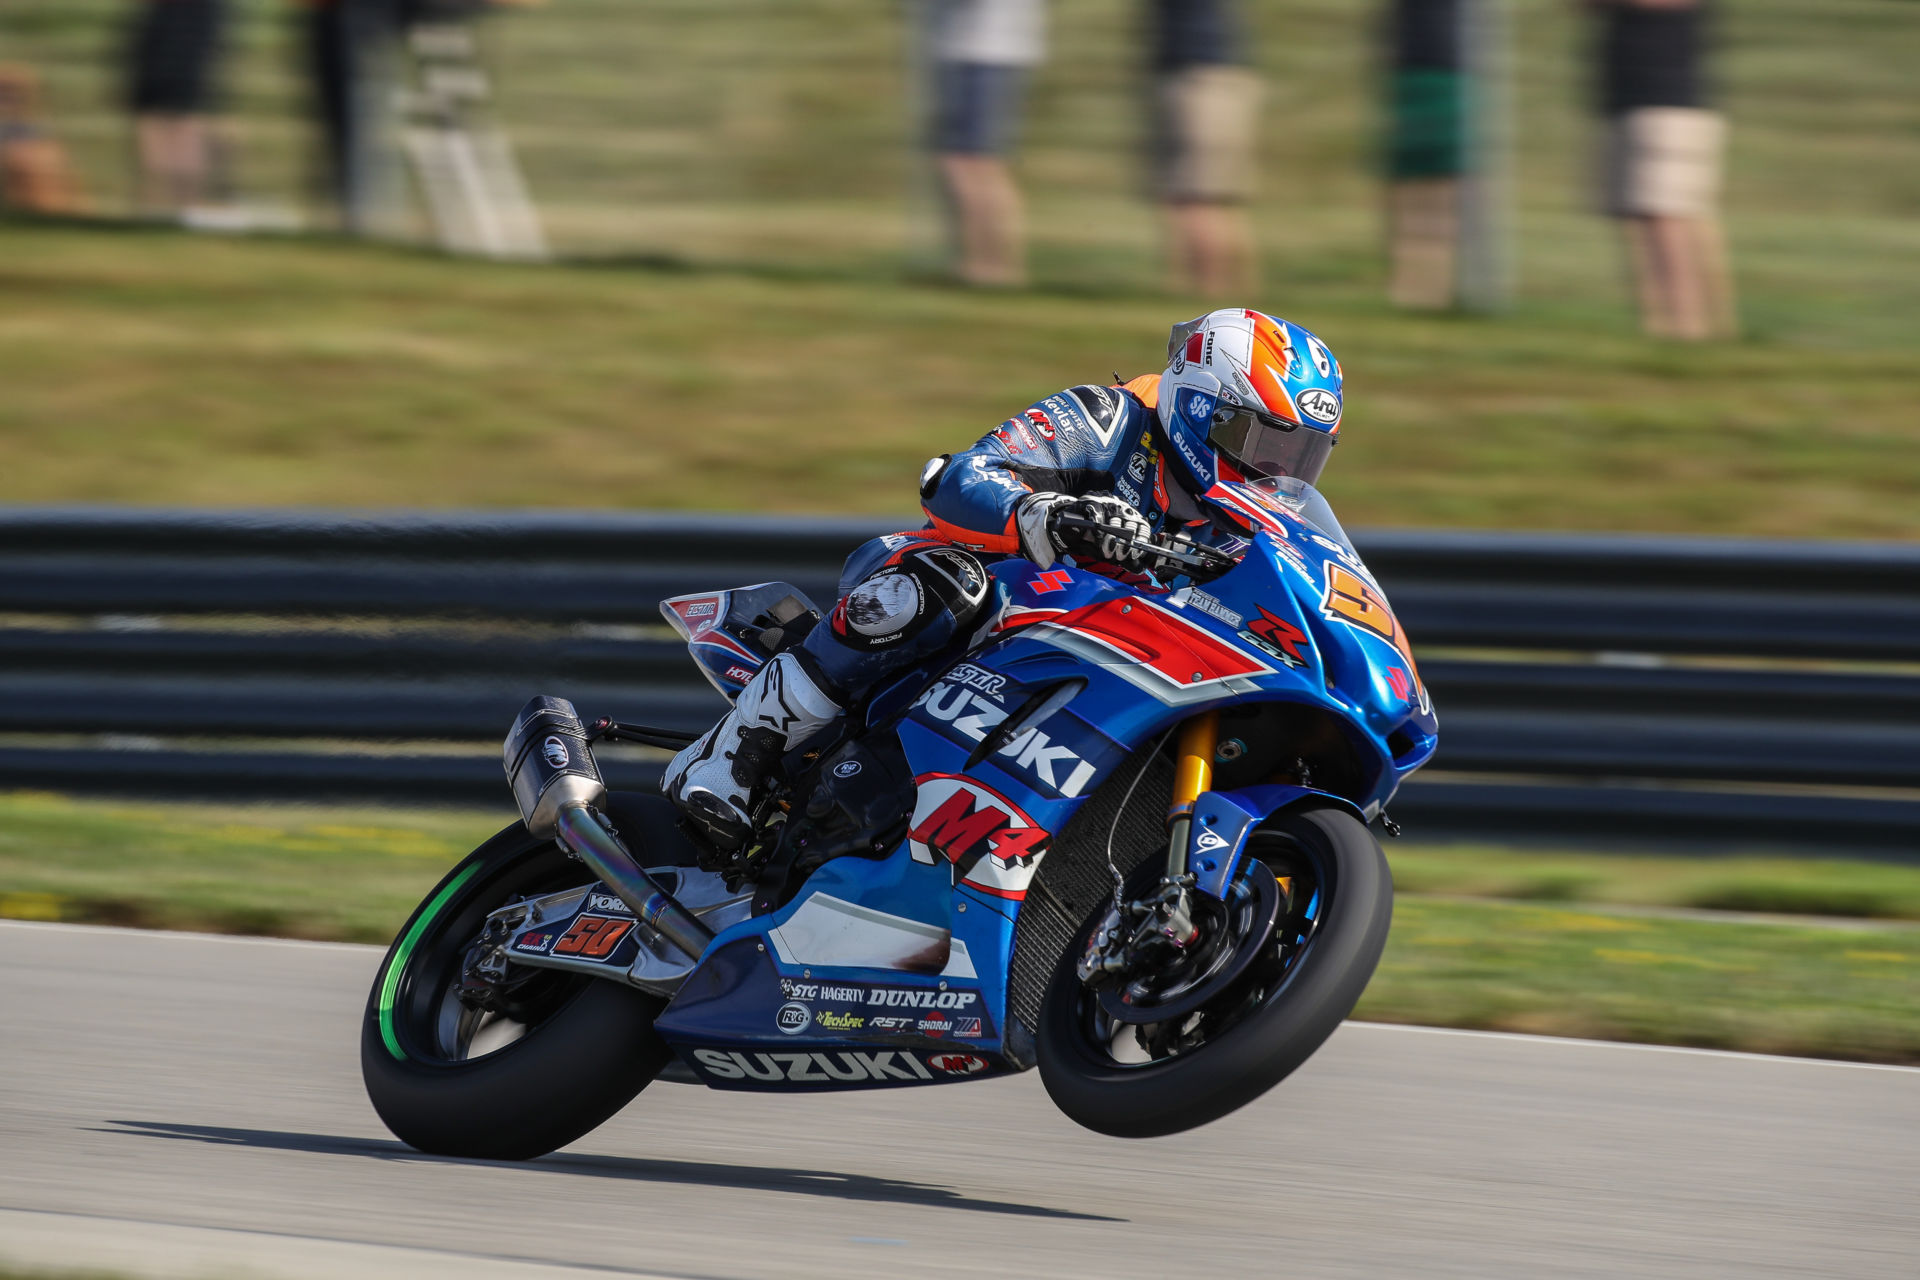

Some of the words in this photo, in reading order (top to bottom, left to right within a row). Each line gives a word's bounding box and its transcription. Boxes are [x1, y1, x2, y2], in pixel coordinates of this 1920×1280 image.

[1041, 398, 1075, 433] Kevlar
[1301, 392, 1337, 416] Arai
[1173, 431, 1212, 482] SUZUKI
[1208, 602, 1243, 628] HAMMER
[1237, 629, 1305, 669] GSX
[909, 788, 1051, 866] M4
[521, 932, 545, 946] EK
[555, 916, 633, 956] 50
[792, 984, 818, 998] STG
[820, 986, 865, 1002] HAGERTY
[866, 988, 977, 1009] DUNLOP
[782, 1010, 805, 1024] R&G
[868, 1017, 914, 1028] RST
[917, 1020, 953, 1031] SHORAI
[694, 1049, 933, 1081] SUZUKI
